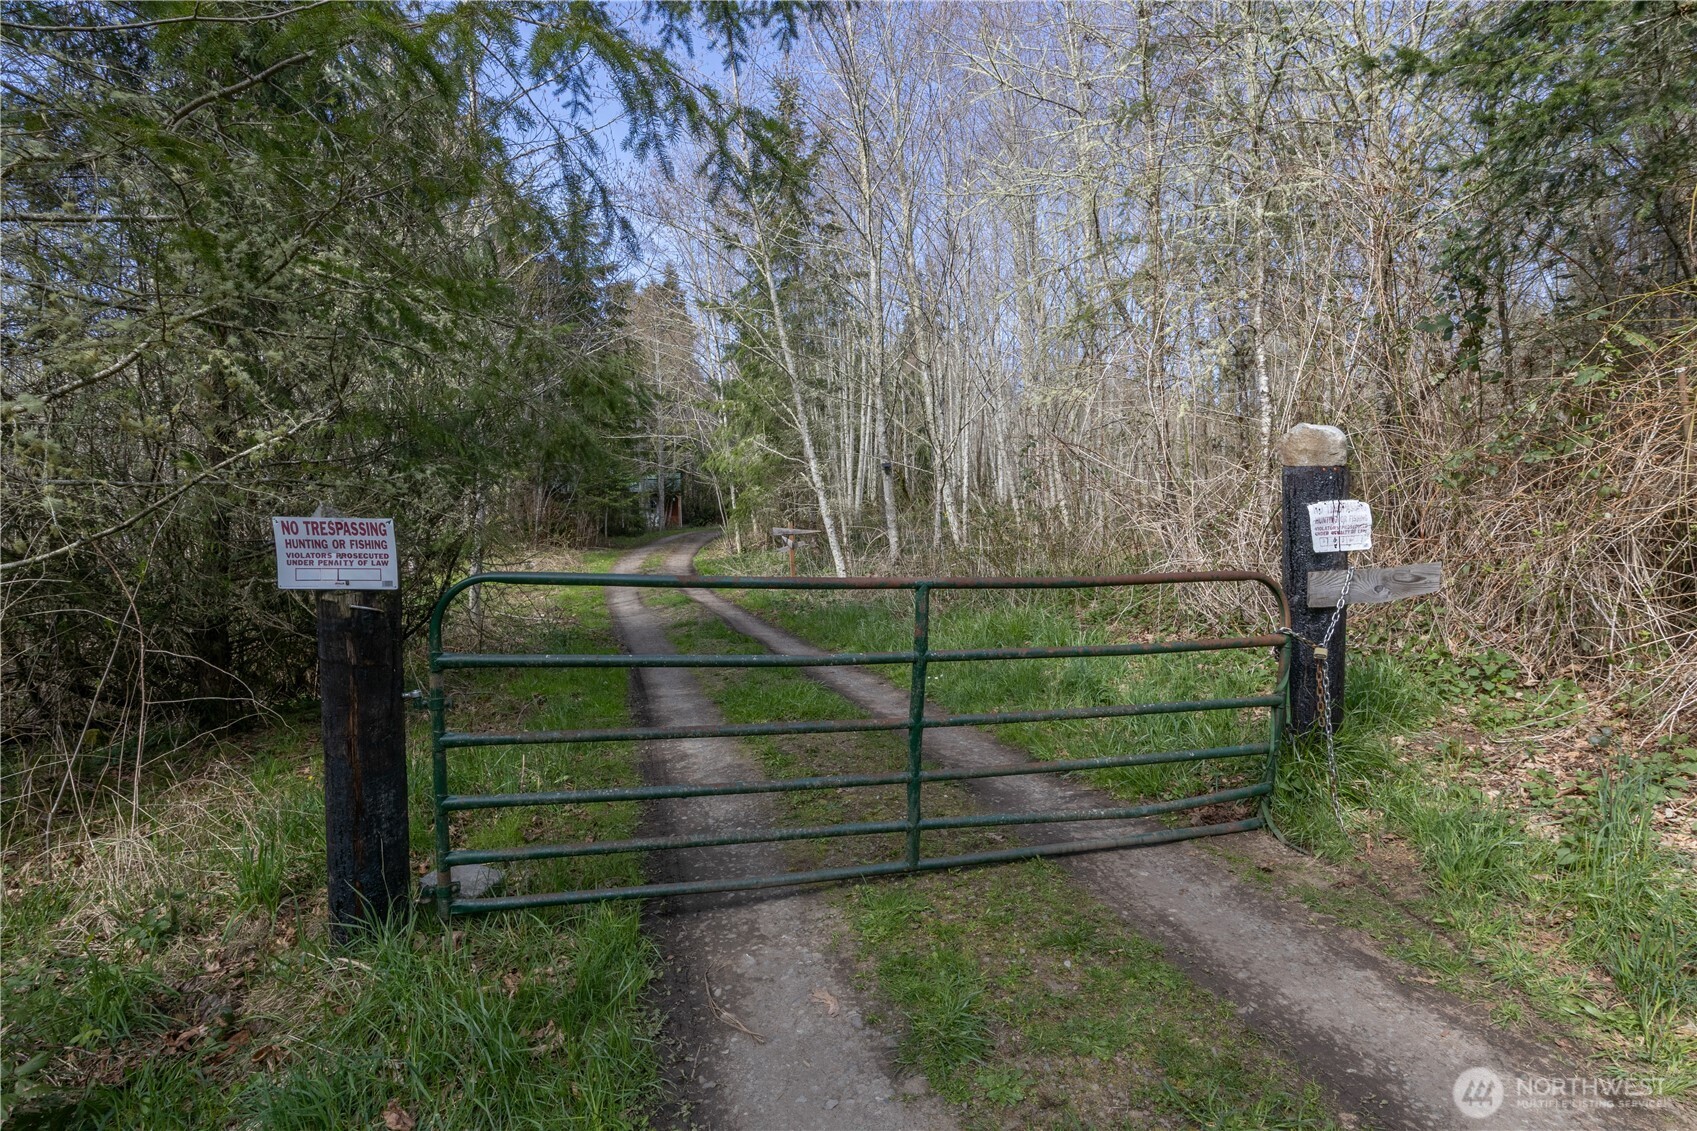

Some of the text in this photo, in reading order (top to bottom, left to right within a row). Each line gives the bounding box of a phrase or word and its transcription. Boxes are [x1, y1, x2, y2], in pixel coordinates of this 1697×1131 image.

[281, 520, 387, 536] NO TRESPASSING
[285, 539, 388, 549] HUNTING OR FISHING
